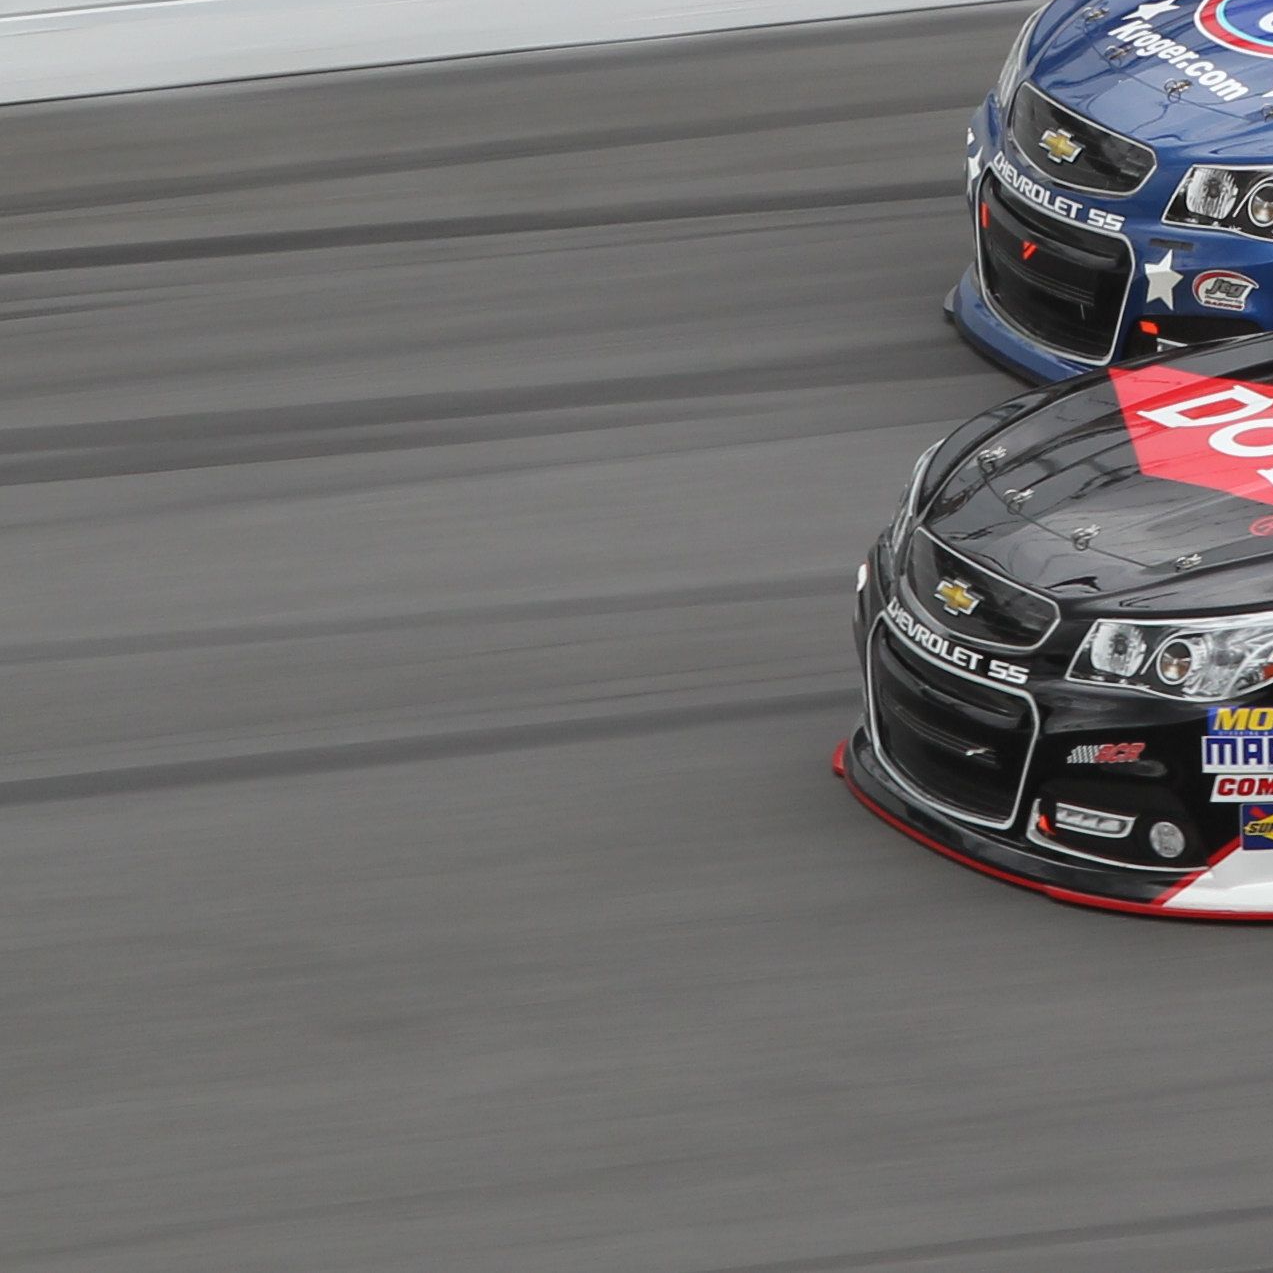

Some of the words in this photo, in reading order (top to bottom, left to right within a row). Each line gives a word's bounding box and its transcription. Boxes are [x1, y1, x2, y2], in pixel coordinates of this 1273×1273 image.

[1106, 19, 1249, 102] Kroger.com
[991, 150, 1085, 221] CHEVROLET
[1086, 208, 1125, 232] SS
[885, 595, 984, 669] CHEVROLET
[987, 659, 1031, 686] SS
